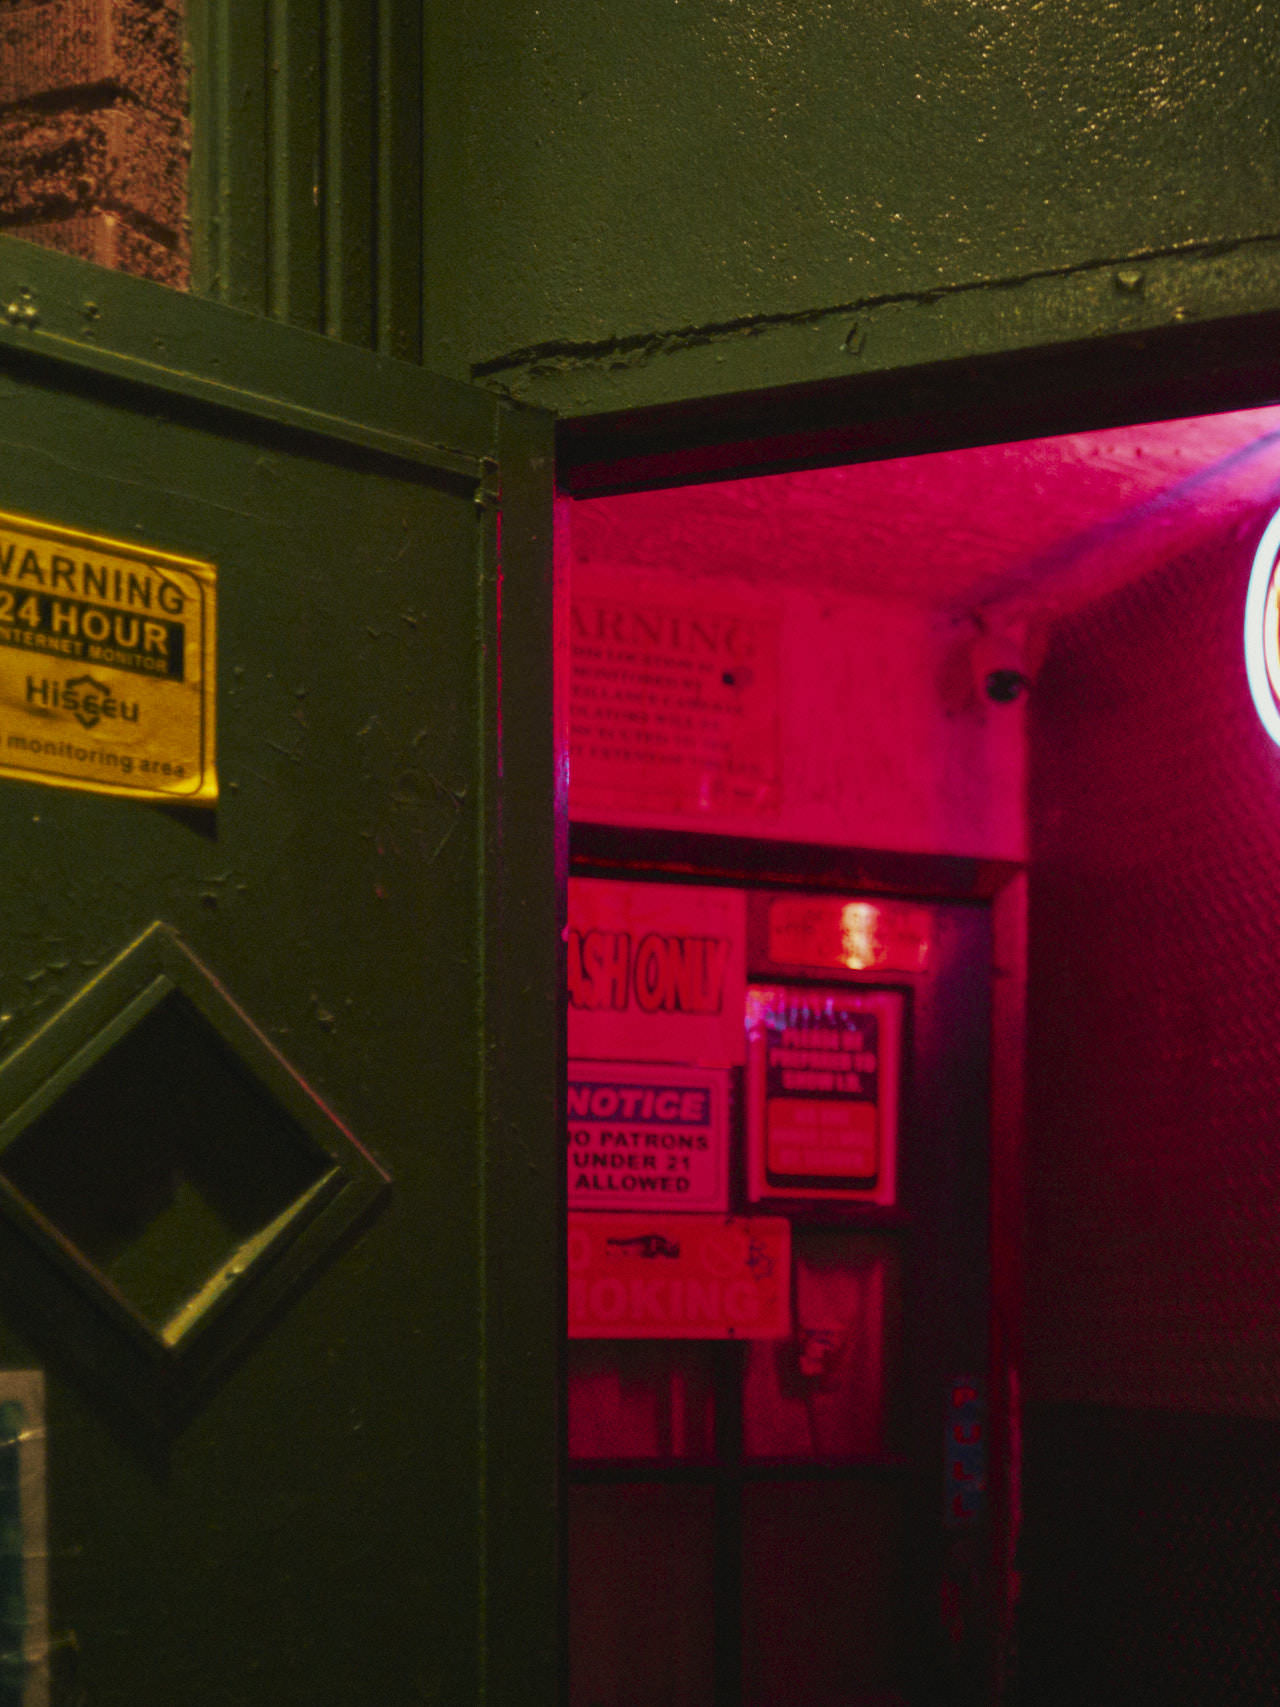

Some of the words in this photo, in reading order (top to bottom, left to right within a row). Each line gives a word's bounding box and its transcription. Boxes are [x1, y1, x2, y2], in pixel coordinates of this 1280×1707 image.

[0, 590, 41, 628] 24
[52, 602, 169, 655] HOUR
[572, 604, 757, 658] ARNING
[88, 644, 168, 674] MONITOR
[7, 734, 133, 774] monitoring
[138, 759, 186, 779] area
[567, 925, 632, 1012] ASH
[633, 931, 733, 1016] ONLY
[567, 1084, 706, 1121] NOTICE
[600, 1131, 708, 1151] PATRONS
[573, 1152, 657, 1170] UNDER
[667, 1155, 690, 1172] 21
[575, 1173, 690, 1193] ALLOWED
[568, 1228, 591, 1272] O
